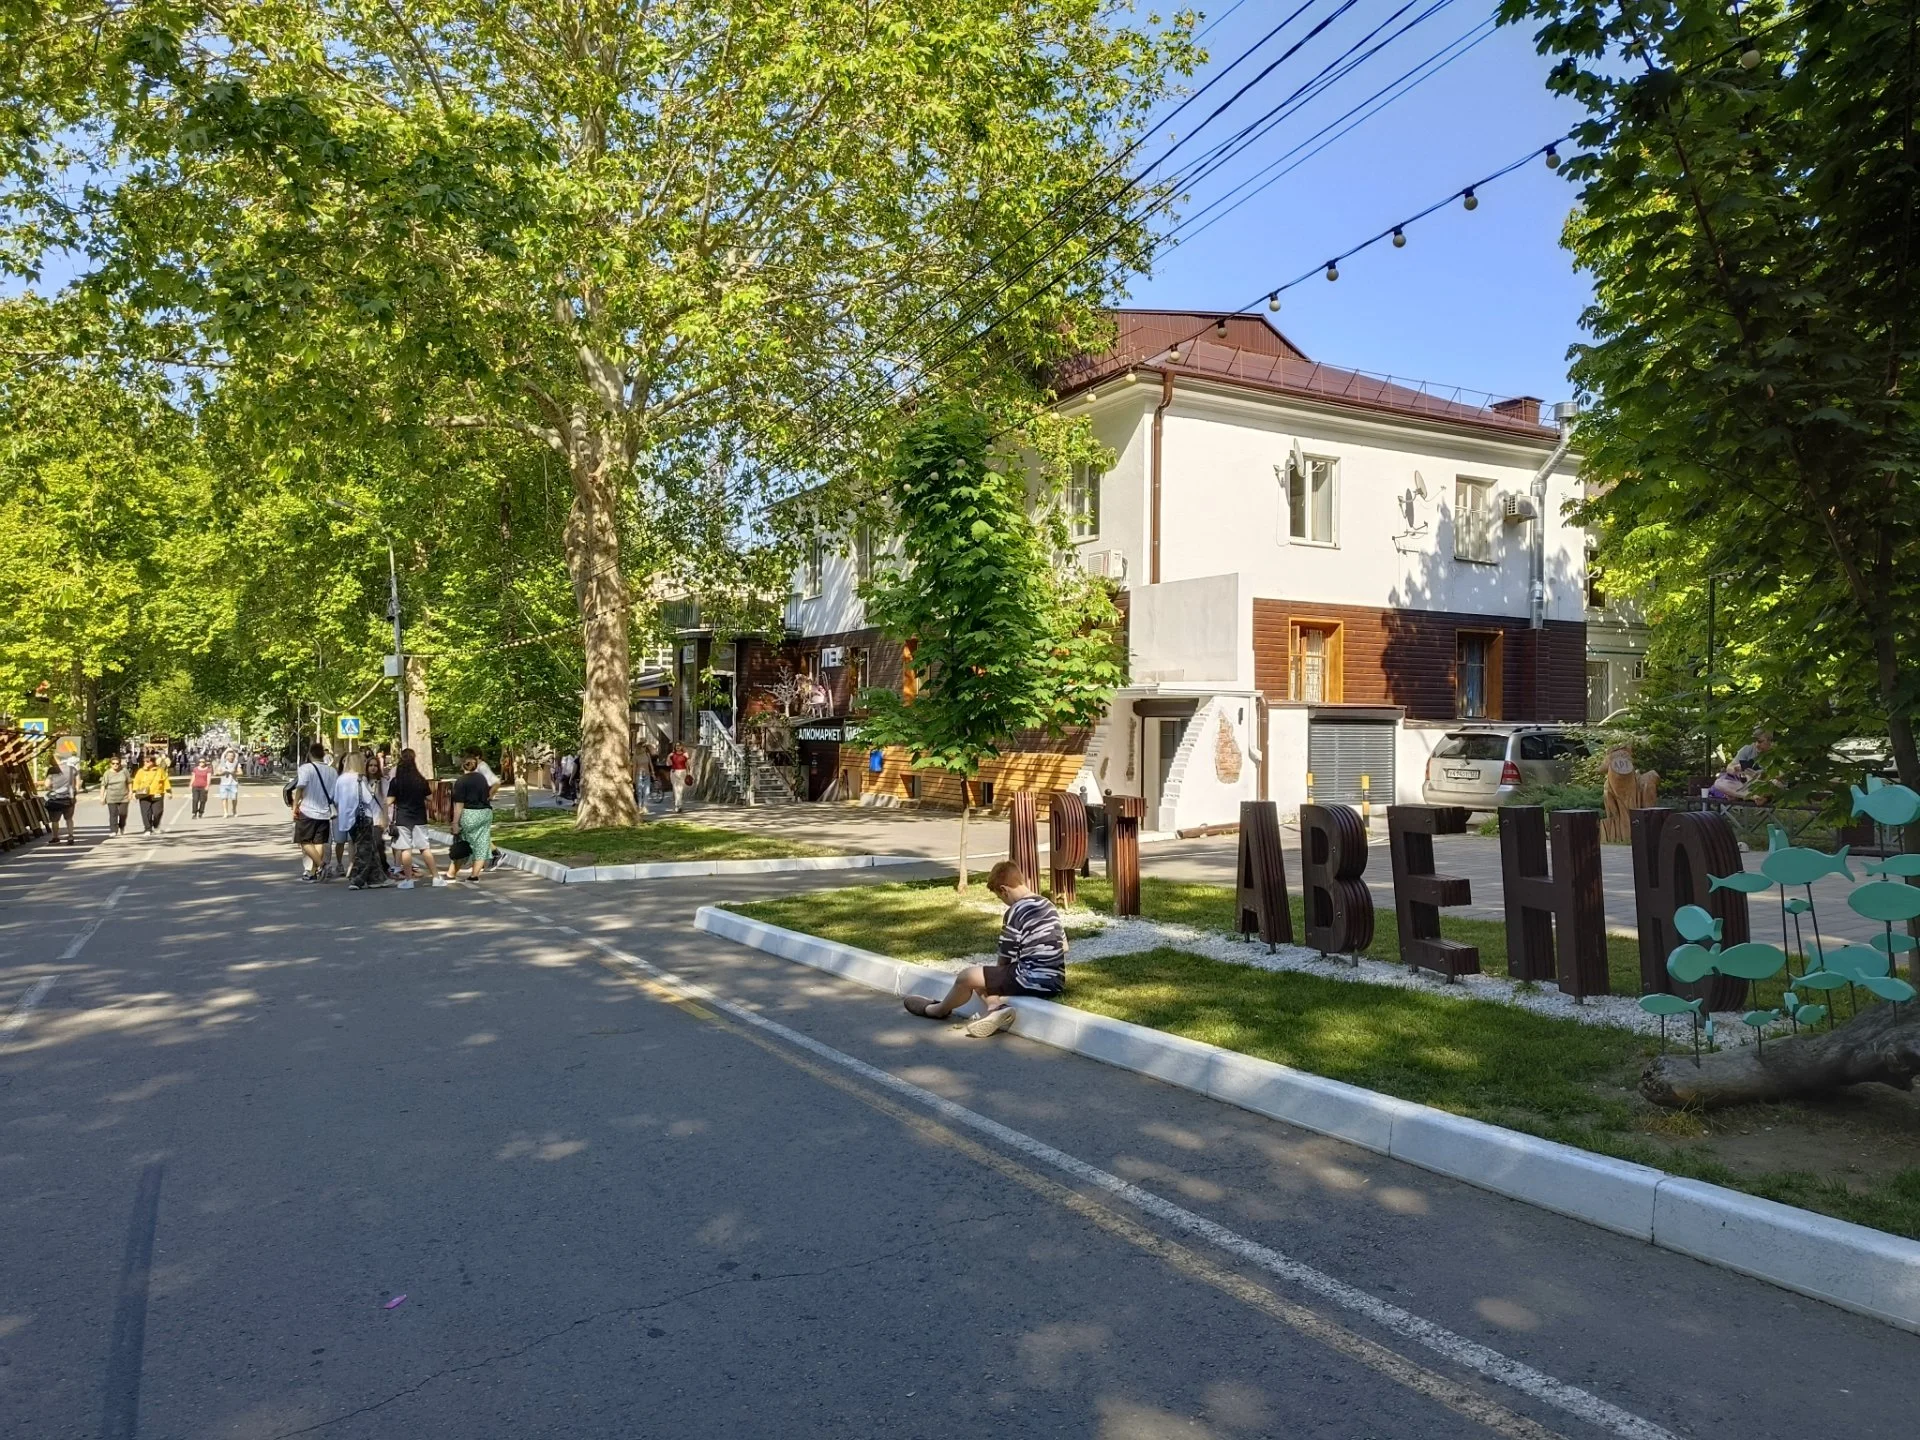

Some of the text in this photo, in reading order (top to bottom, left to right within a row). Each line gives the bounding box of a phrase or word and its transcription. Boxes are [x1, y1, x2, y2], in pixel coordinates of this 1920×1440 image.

[798, 728, 841, 741] АЛКОМАРКЕТ
[1008, 791, 1749, 1012] АРТ АВЕНЮ
